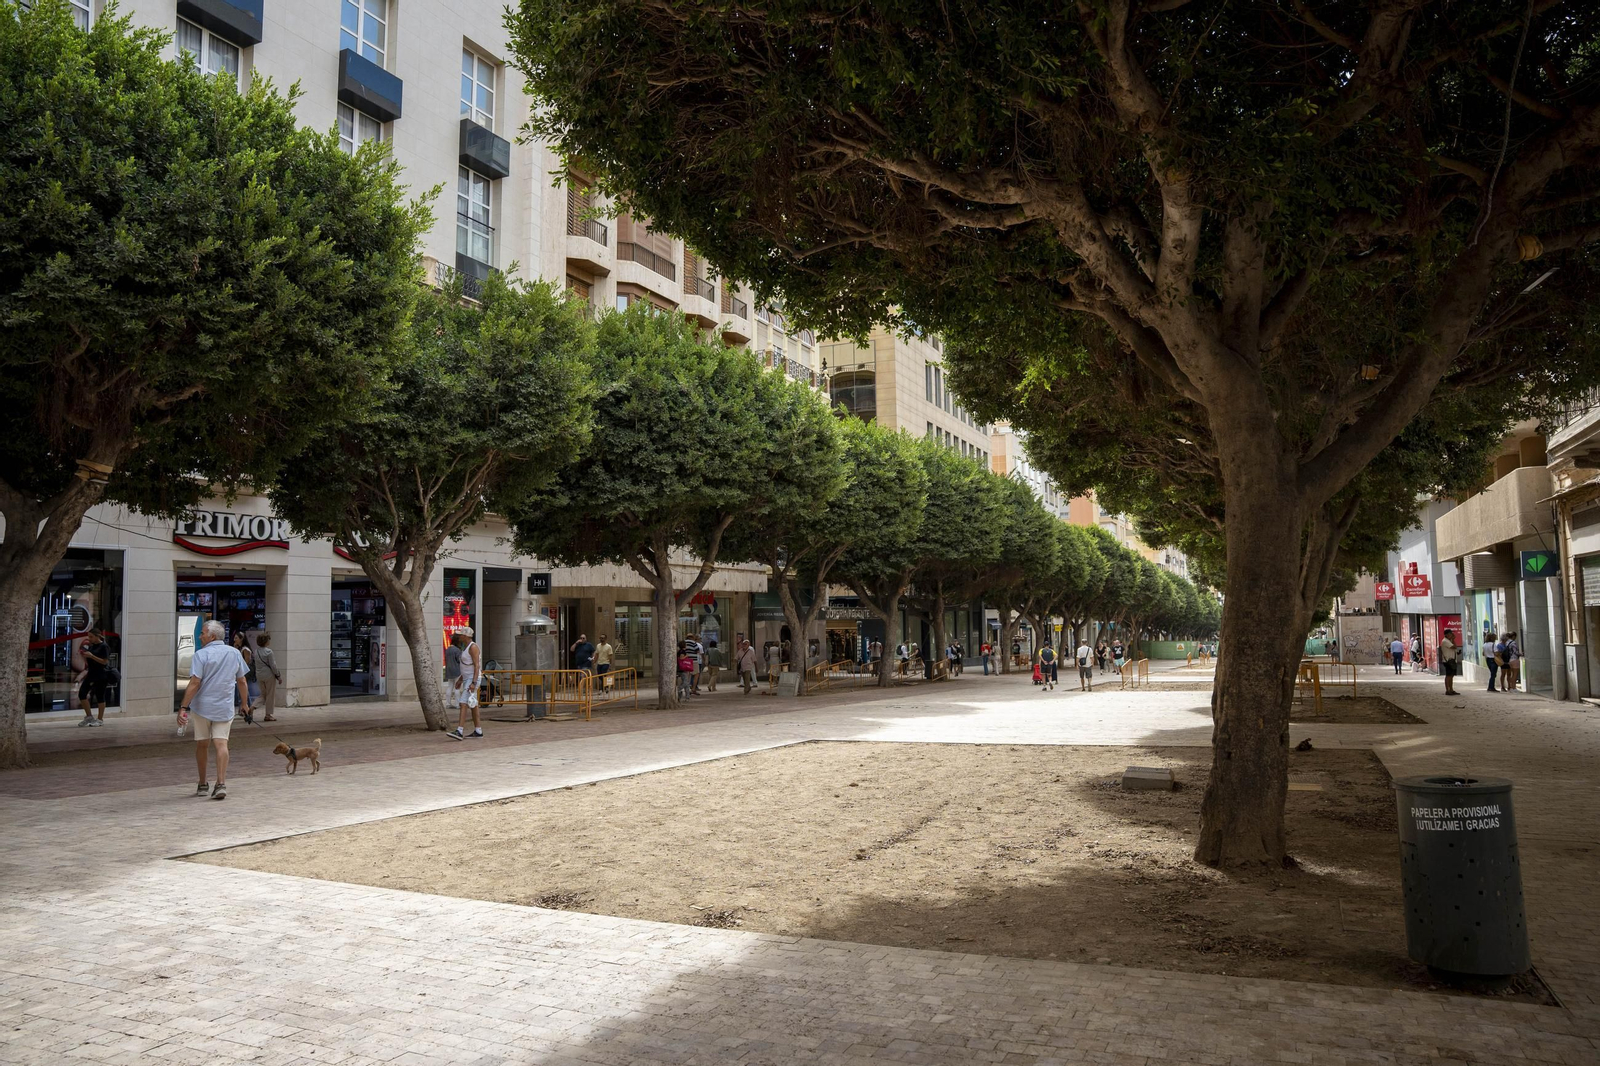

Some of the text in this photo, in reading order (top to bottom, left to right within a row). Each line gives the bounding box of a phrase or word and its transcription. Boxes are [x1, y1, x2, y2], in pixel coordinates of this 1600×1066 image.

[175, 509, 289, 541] PRIMOR
[1410, 804, 1502, 819] PAPELERA PROVISIONAL
[1465, 817, 1500, 831] GRACIAS
